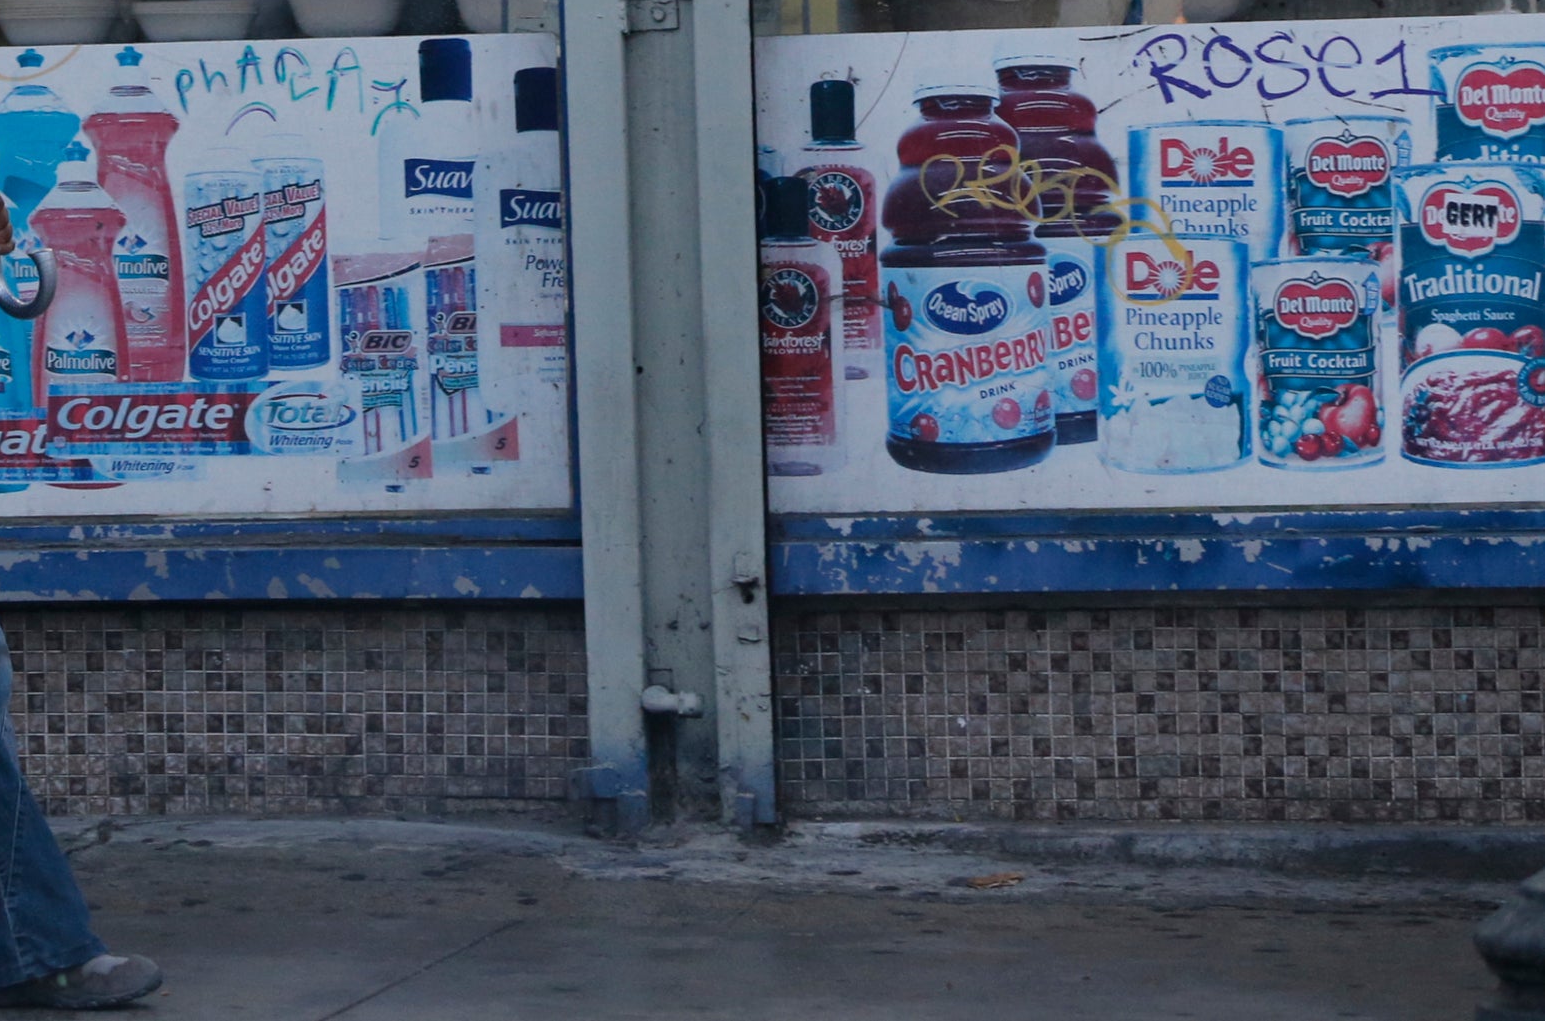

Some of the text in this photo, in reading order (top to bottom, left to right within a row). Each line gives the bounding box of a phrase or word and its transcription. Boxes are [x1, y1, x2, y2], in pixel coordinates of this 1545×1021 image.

[1461, 86, 1490, 104] Del
[1160, 137, 1255, 183] Dole
[1311, 154, 1385, 171] Del Monte
[188, 205, 224, 225] SPECIAL
[1160, 194, 1258, 217] Pineapple
[1445, 201, 1500, 229] GERT
[1300, 213, 1333, 226] Fruit
[1126, 250, 1220, 297] Dole
[1404, 264, 1542, 303] Traditional
[189, 241, 263, 330] Colgate
[928, 292, 1005, 325] Ocean Spray
[1280, 297, 1353, 315] Del Monte
[1126, 307, 1223, 331] Pineapple
[1431, 309, 1515, 324] Spaghetti Sauce
[1134, 331, 1215, 351] Chunks
[47, 350, 117, 370] Palmolive
[1058, 352, 1095, 371] DRINK
[1269, 353, 1367, 369] Fruit Cocktail
[1140, 362, 1178, 379] 100%
[362, 370, 410, 394] encils
[980, 382, 1016, 400] DRINK
[56, 397, 234, 439] Colgate
[264, 401, 344, 424] Total
[269, 434, 334, 449] Whitening
[494, 437, 508, 451] 5
[110, 459, 175, 473] Whitening
[408, 455, 422, 469] 5
